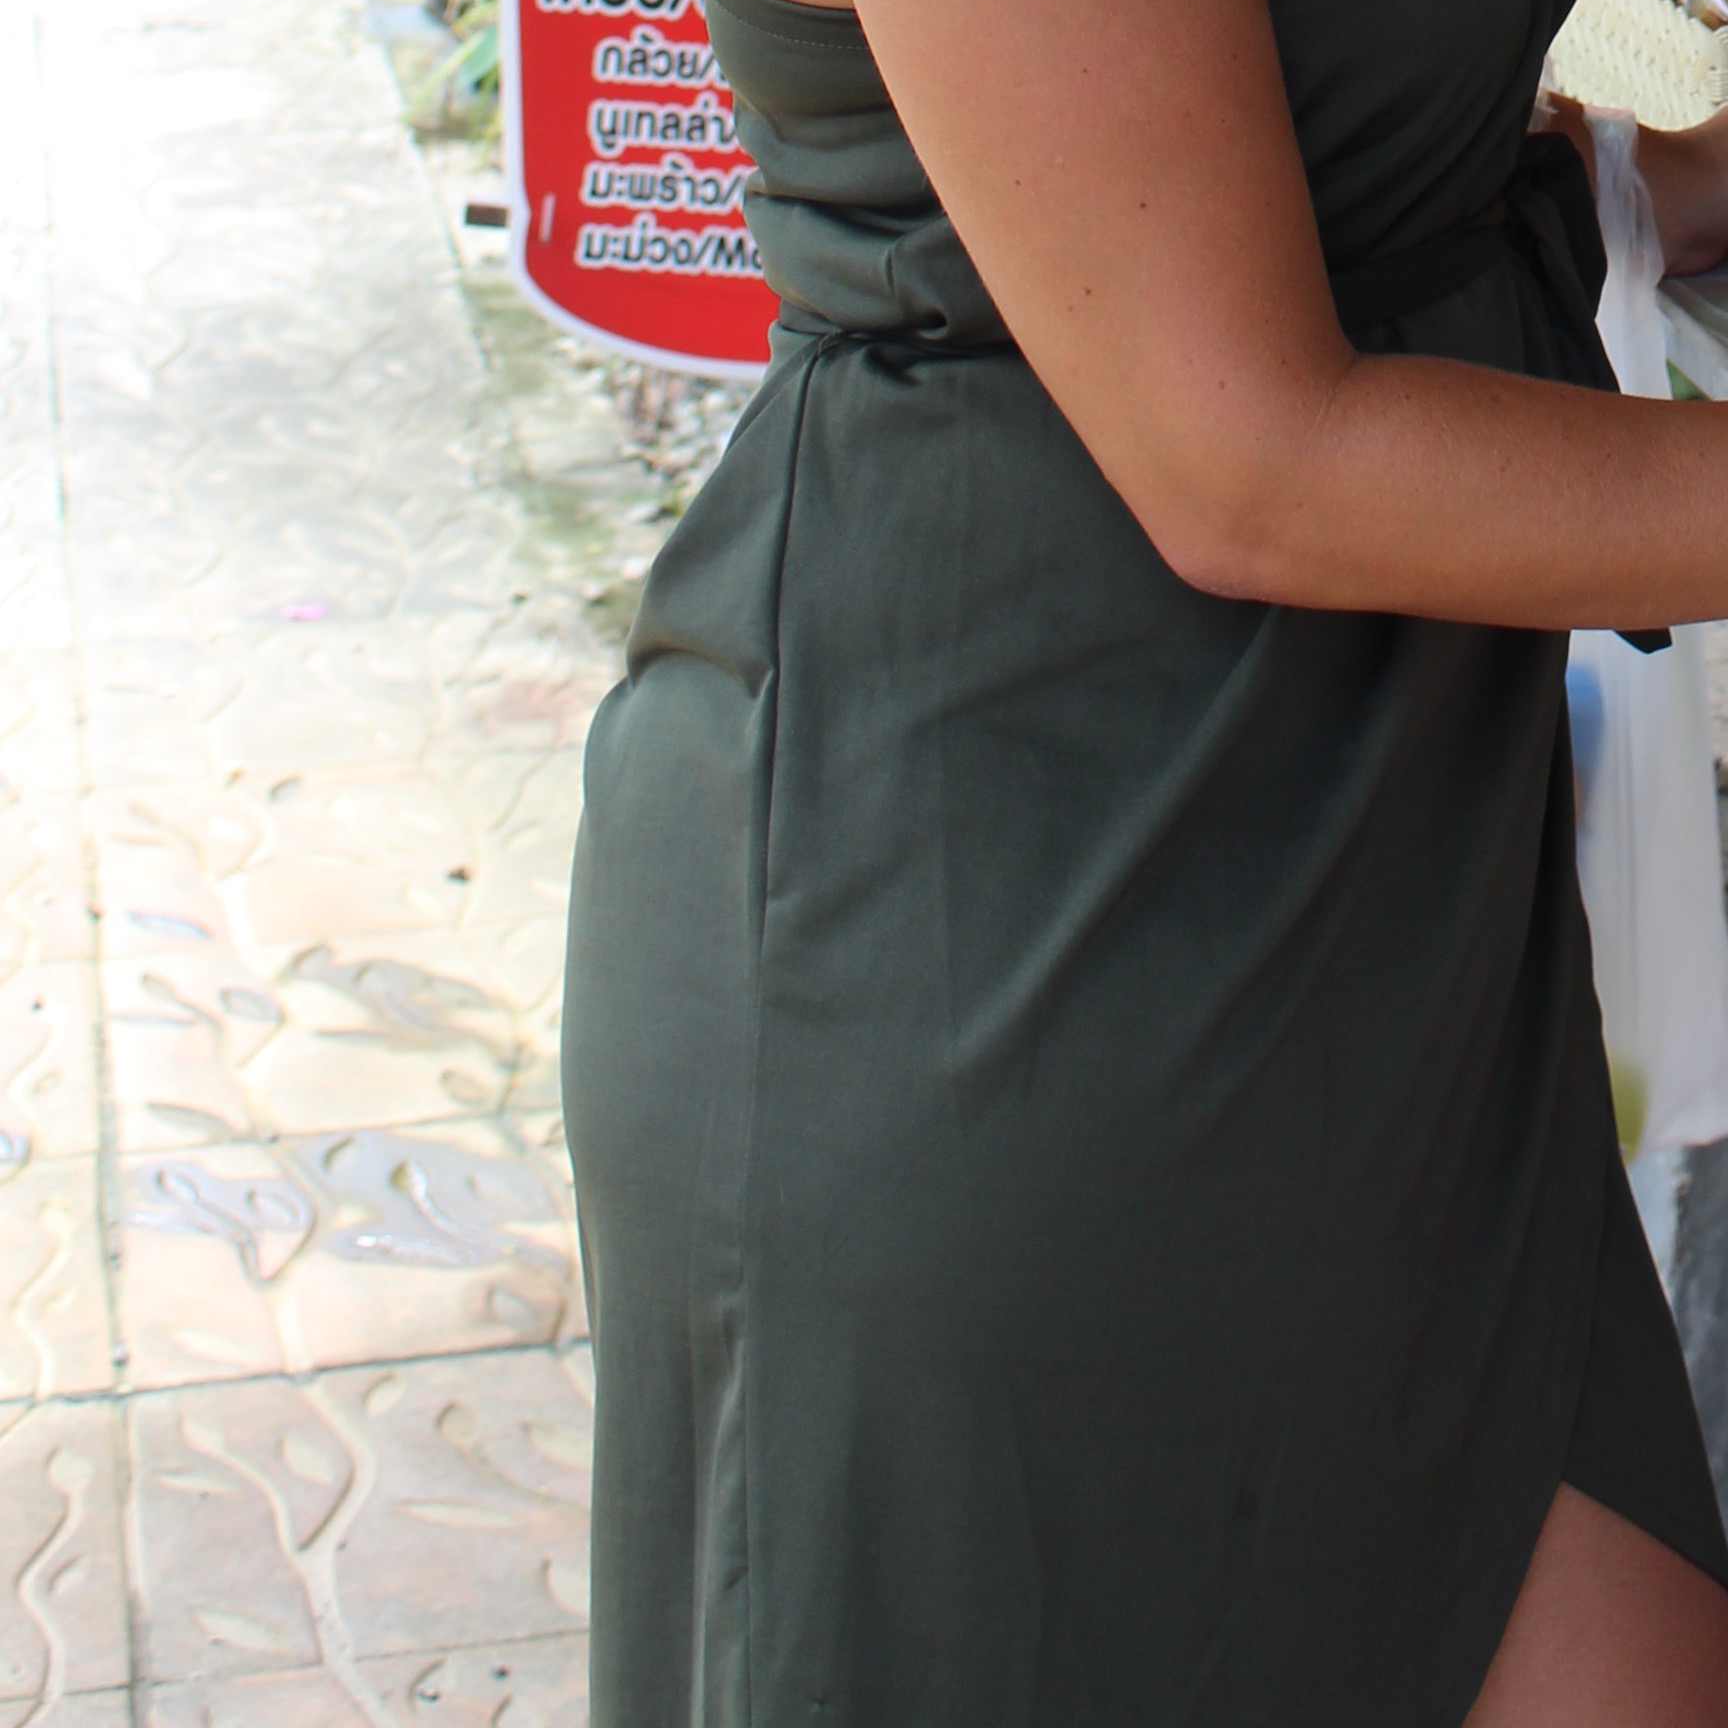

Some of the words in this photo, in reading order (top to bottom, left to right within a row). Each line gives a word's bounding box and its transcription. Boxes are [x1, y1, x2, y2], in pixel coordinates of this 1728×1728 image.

[598, 32, 728, 84] กล้วย/
[588, 159, 743, 208] มะพร้าว/
